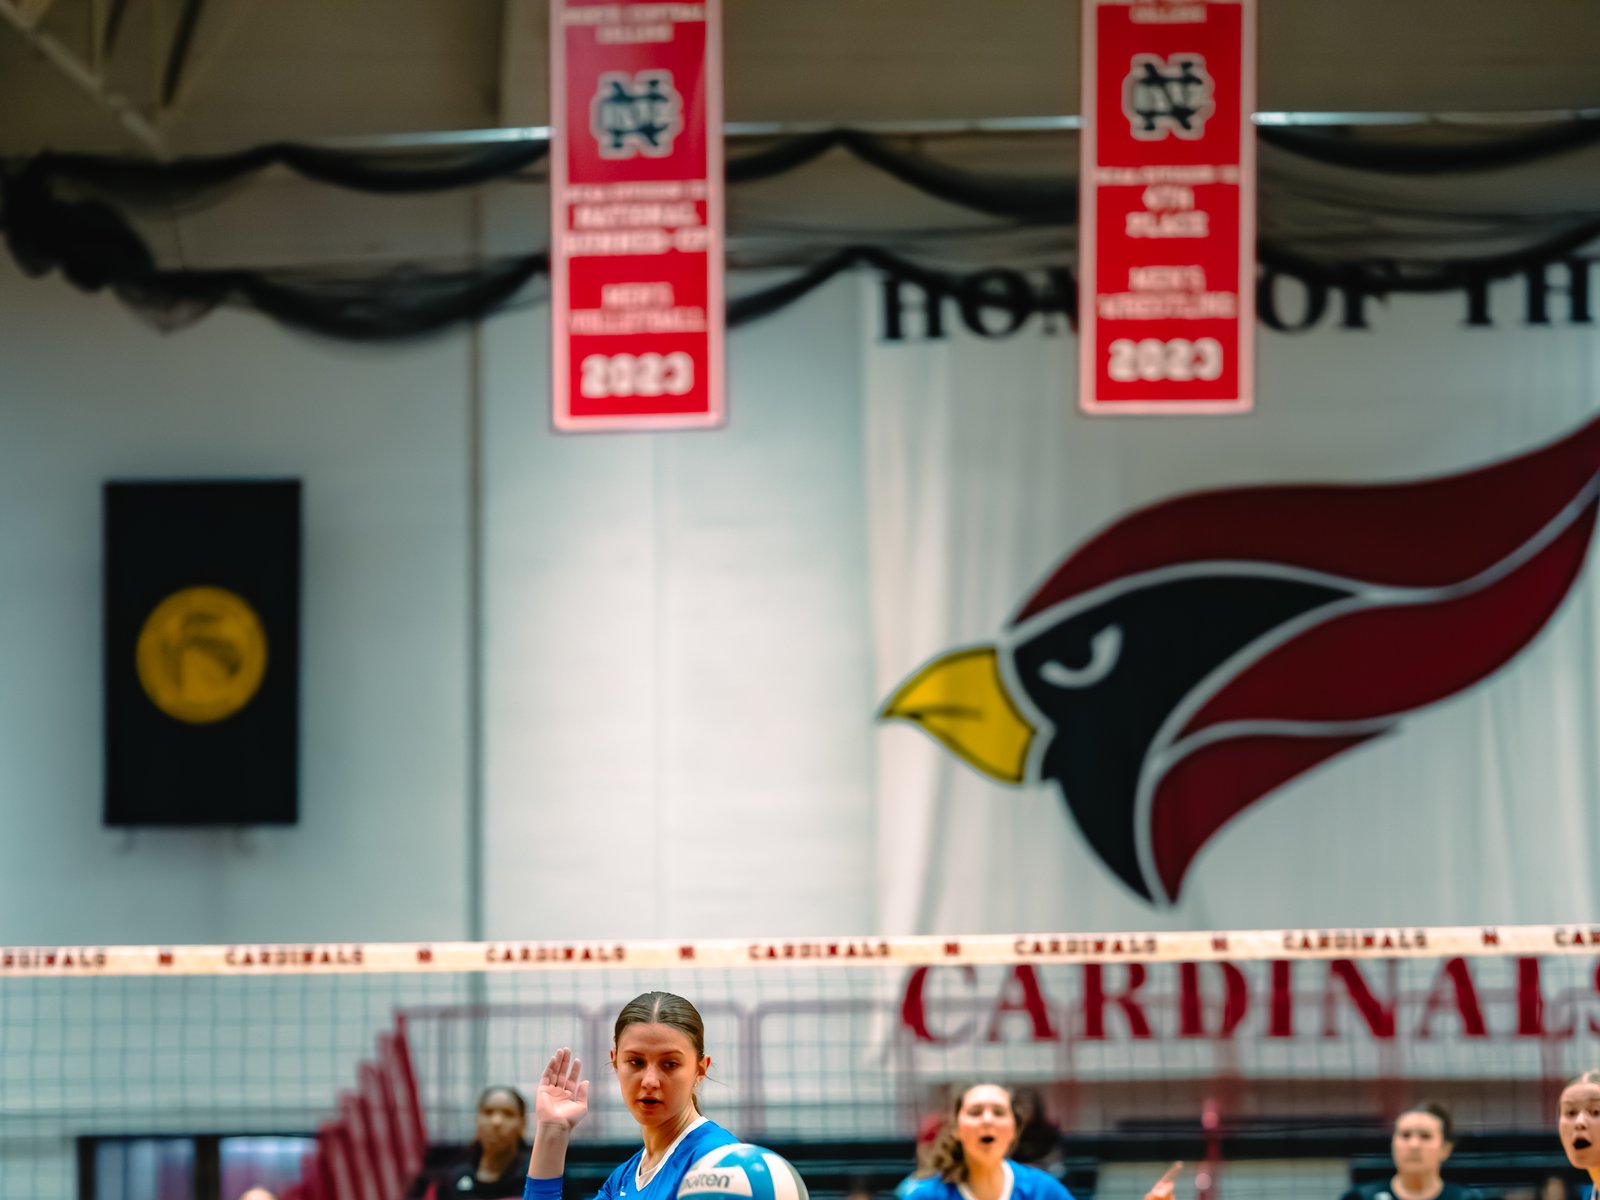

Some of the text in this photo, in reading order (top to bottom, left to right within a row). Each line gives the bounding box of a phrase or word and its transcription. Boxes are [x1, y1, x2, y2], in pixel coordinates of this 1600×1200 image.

[580, 352, 695, 399] 2023
[1108, 338, 1224, 382] 2023
[225, 949, 363, 966] CARDINALS
[486, 946, 626, 962] CARDINALS
[748, 942, 890, 959] CARDINALS
[1014, 938, 1158, 955] CARDINALS
[1283, 931, 1427, 949] CARDINALS
